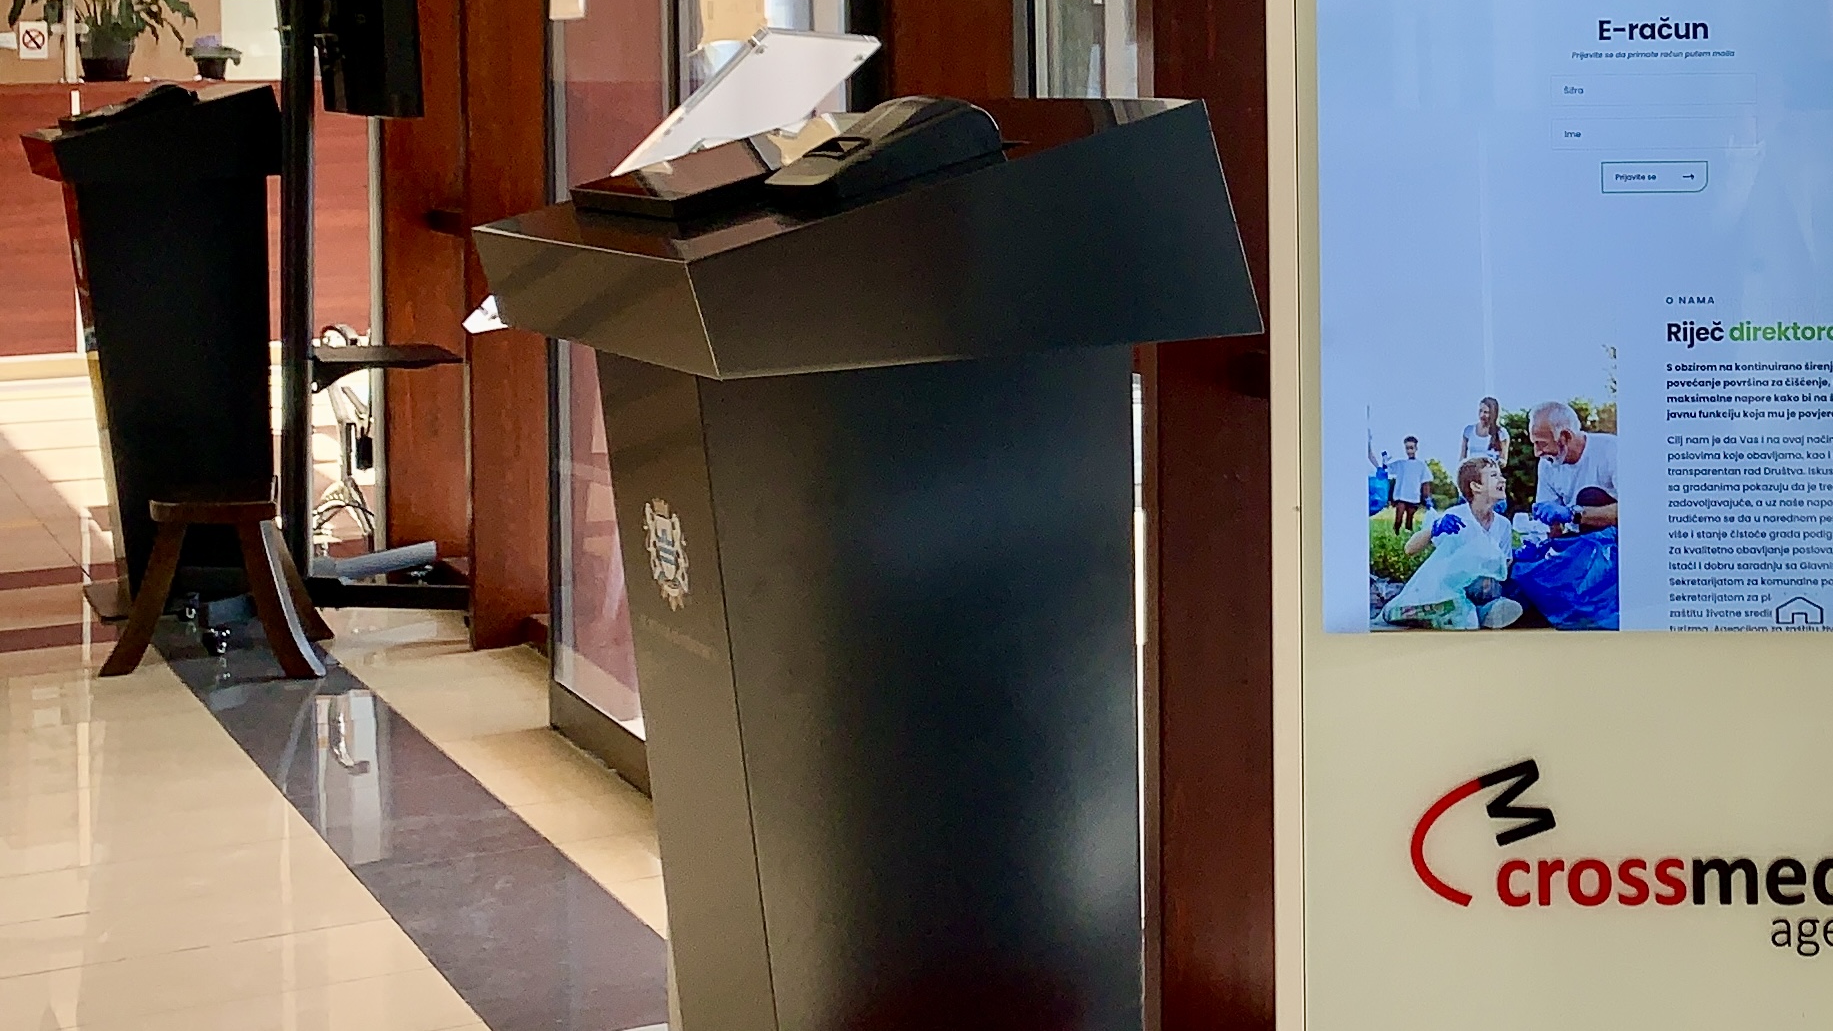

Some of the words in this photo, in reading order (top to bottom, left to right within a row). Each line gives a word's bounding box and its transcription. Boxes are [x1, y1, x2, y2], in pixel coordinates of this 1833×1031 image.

[1598, 17, 1709, 41] E-račun
[1563, 85, 1584, 95] Šifra
[1564, 130, 1581, 138] Ime
[1615, 173, 1646, 182] Prijavite
[1647, 173, 1657, 181] se
[1665, 296, 1674, 305] O
[1678, 296, 1715, 305] NAMA
[1667, 320, 1725, 349] Riječ
[1674, 362, 1717, 371] obzirom
[1734, 362, 1802, 371] kontinuirano
[1666, 378, 1721, 389] povećanje
[1723, 377, 1769, 389] površina
[1666, 394, 1733, 403] maksimalne
[1734, 395, 1772, 405] napore
[1774, 394, 1800, 402] kako
[1802, 393, 1812, 402] bi
[1666, 409, 1696, 421] javnu
[1698, 409, 1741, 420] funkciju
[1743, 409, 1765, 420] koja
[1786, 409, 1796, 420] je
[1667, 435, 1683, 447] Cilj
[1712, 435, 1721, 446] je
[1723, 435, 1737, 444] da
[1739, 435, 1758, 444] Vas
[1782, 435, 1804, 446] ovaj
[1742, 483, 1788, 493] pokazuju
[1791, 483, 1805, 491] da
[1807, 482, 1817, 493] je
